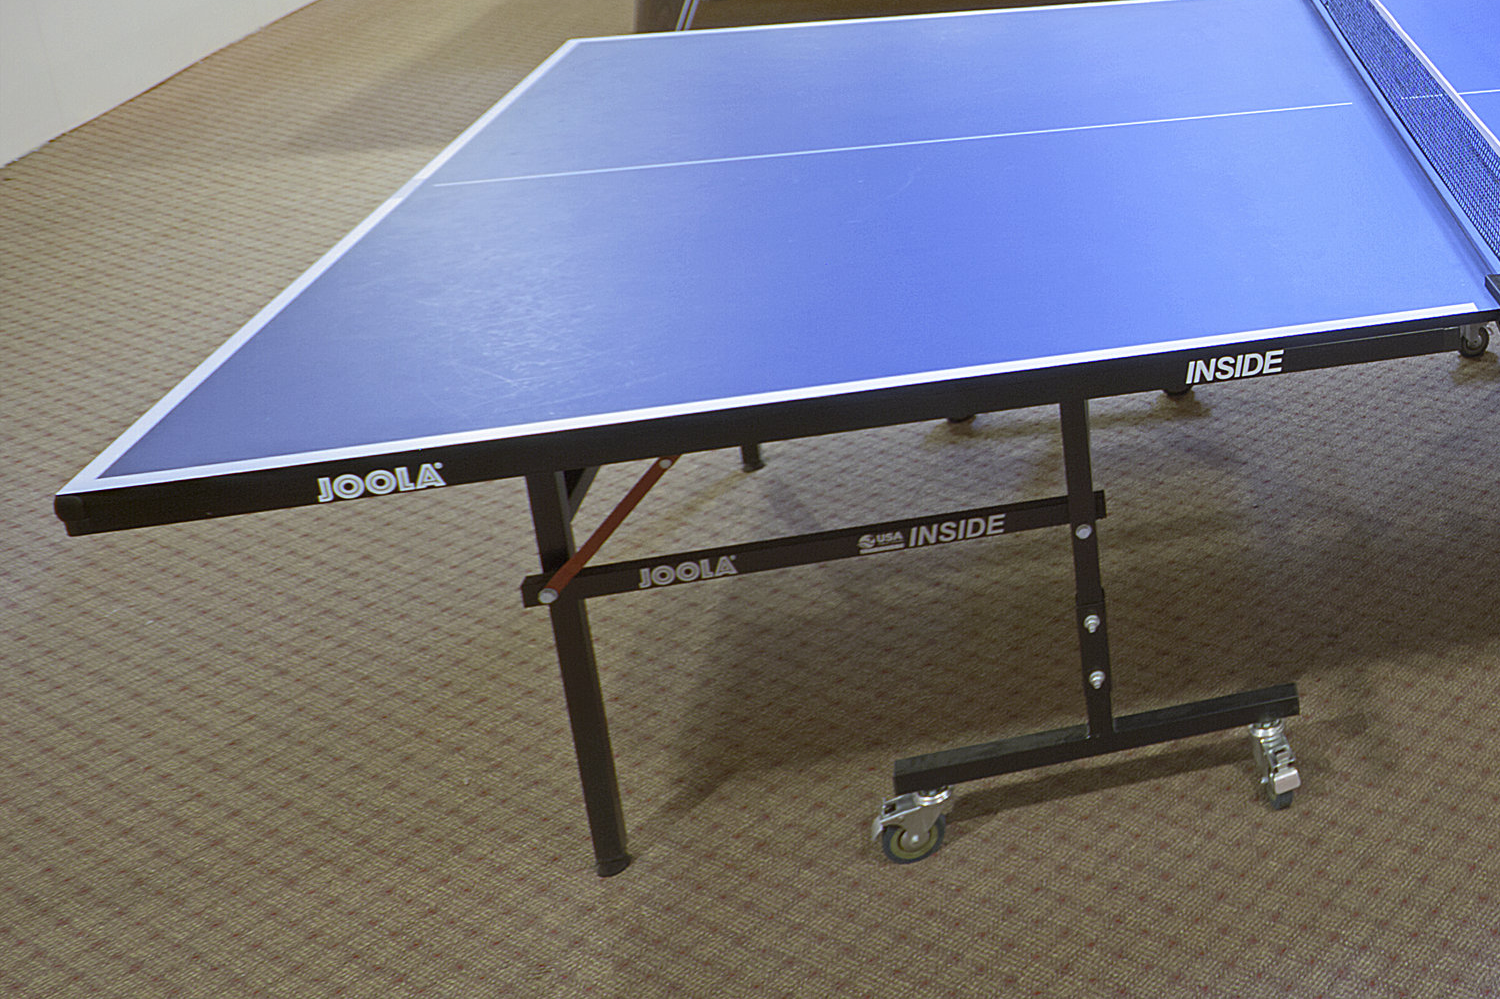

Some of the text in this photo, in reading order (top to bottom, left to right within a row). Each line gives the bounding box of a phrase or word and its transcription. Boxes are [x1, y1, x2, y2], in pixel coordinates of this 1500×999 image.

[1186, 349, 1285, 384] INSIDE
[317, 462, 446, 502] JOOLA
[876, 513, 1006, 548] USA INSIDE
[639, 555, 738, 588] JOOLA
